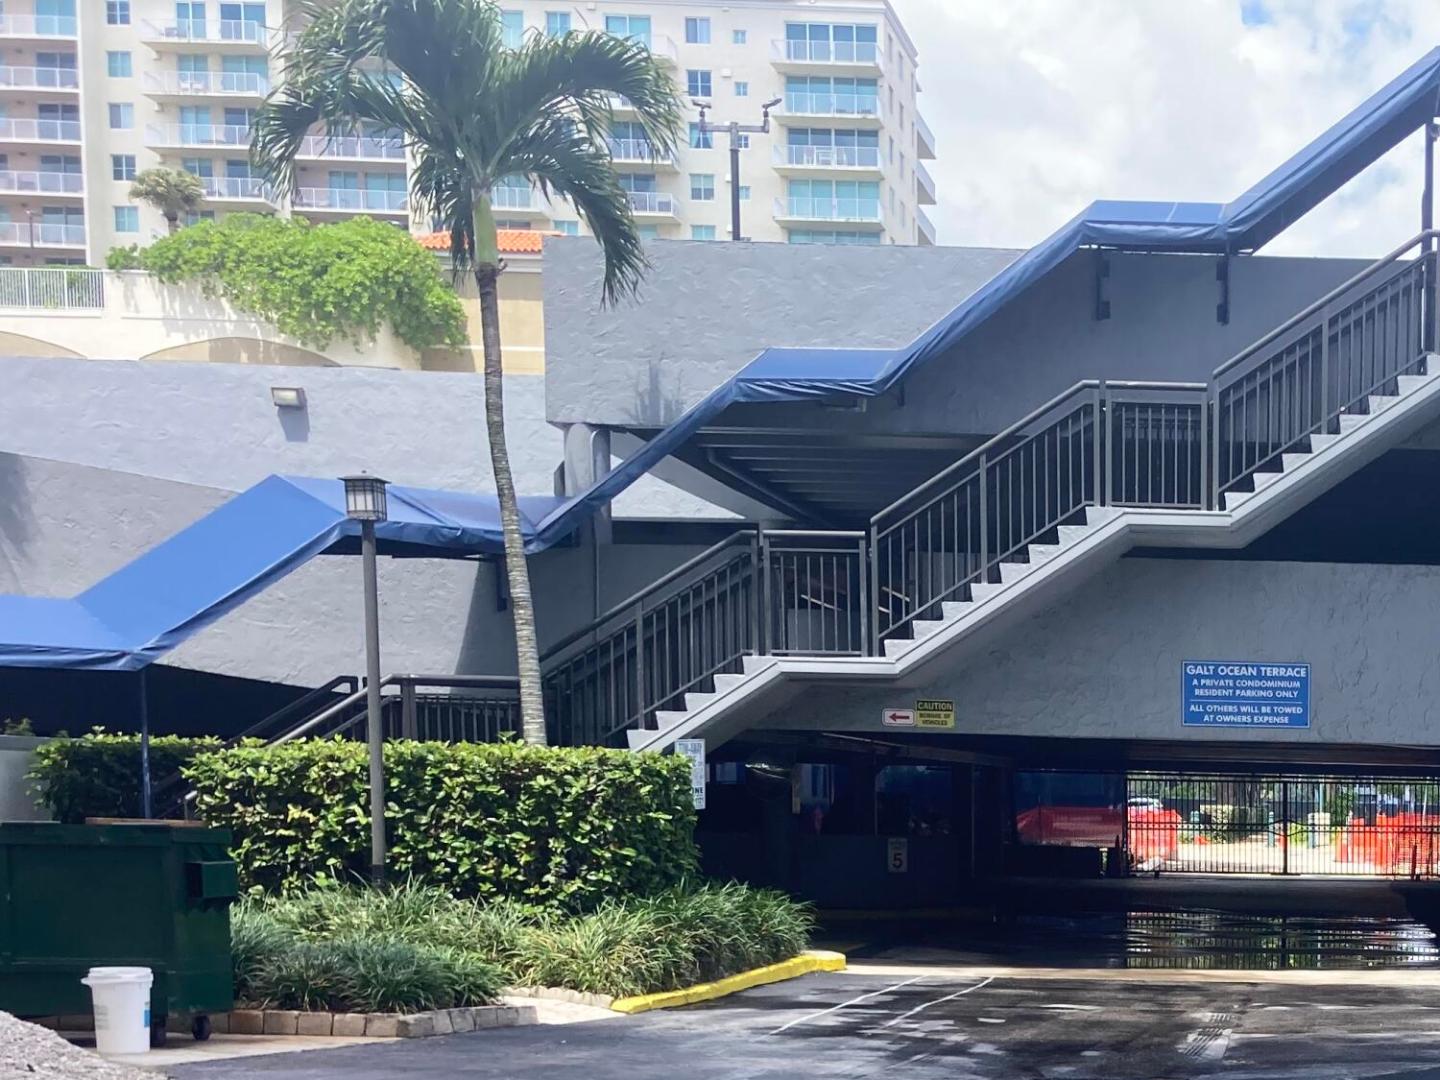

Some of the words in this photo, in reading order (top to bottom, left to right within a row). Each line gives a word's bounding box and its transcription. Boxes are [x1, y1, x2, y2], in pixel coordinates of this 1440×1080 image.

[1186, 665, 1215, 676] GALT
[1218, 666, 1257, 677] OCEAN
[1260, 667, 1307, 677] TERRACE
[1236, 680, 1300, 688] CONDOMINIUM
[1195, 689, 1233, 697] RESIDENT
[1236, 689, 1273, 698] PARKING
[918, 702, 952, 710] CAUTION
[1206, 705, 1238, 713] OTHERS
[1261, 706, 1271, 714] BE
[1216, 715, 1251, 723] OWNERS
[1254, 716, 1289, 724] EXPENSE
[892, 853, 902, 868] 5
